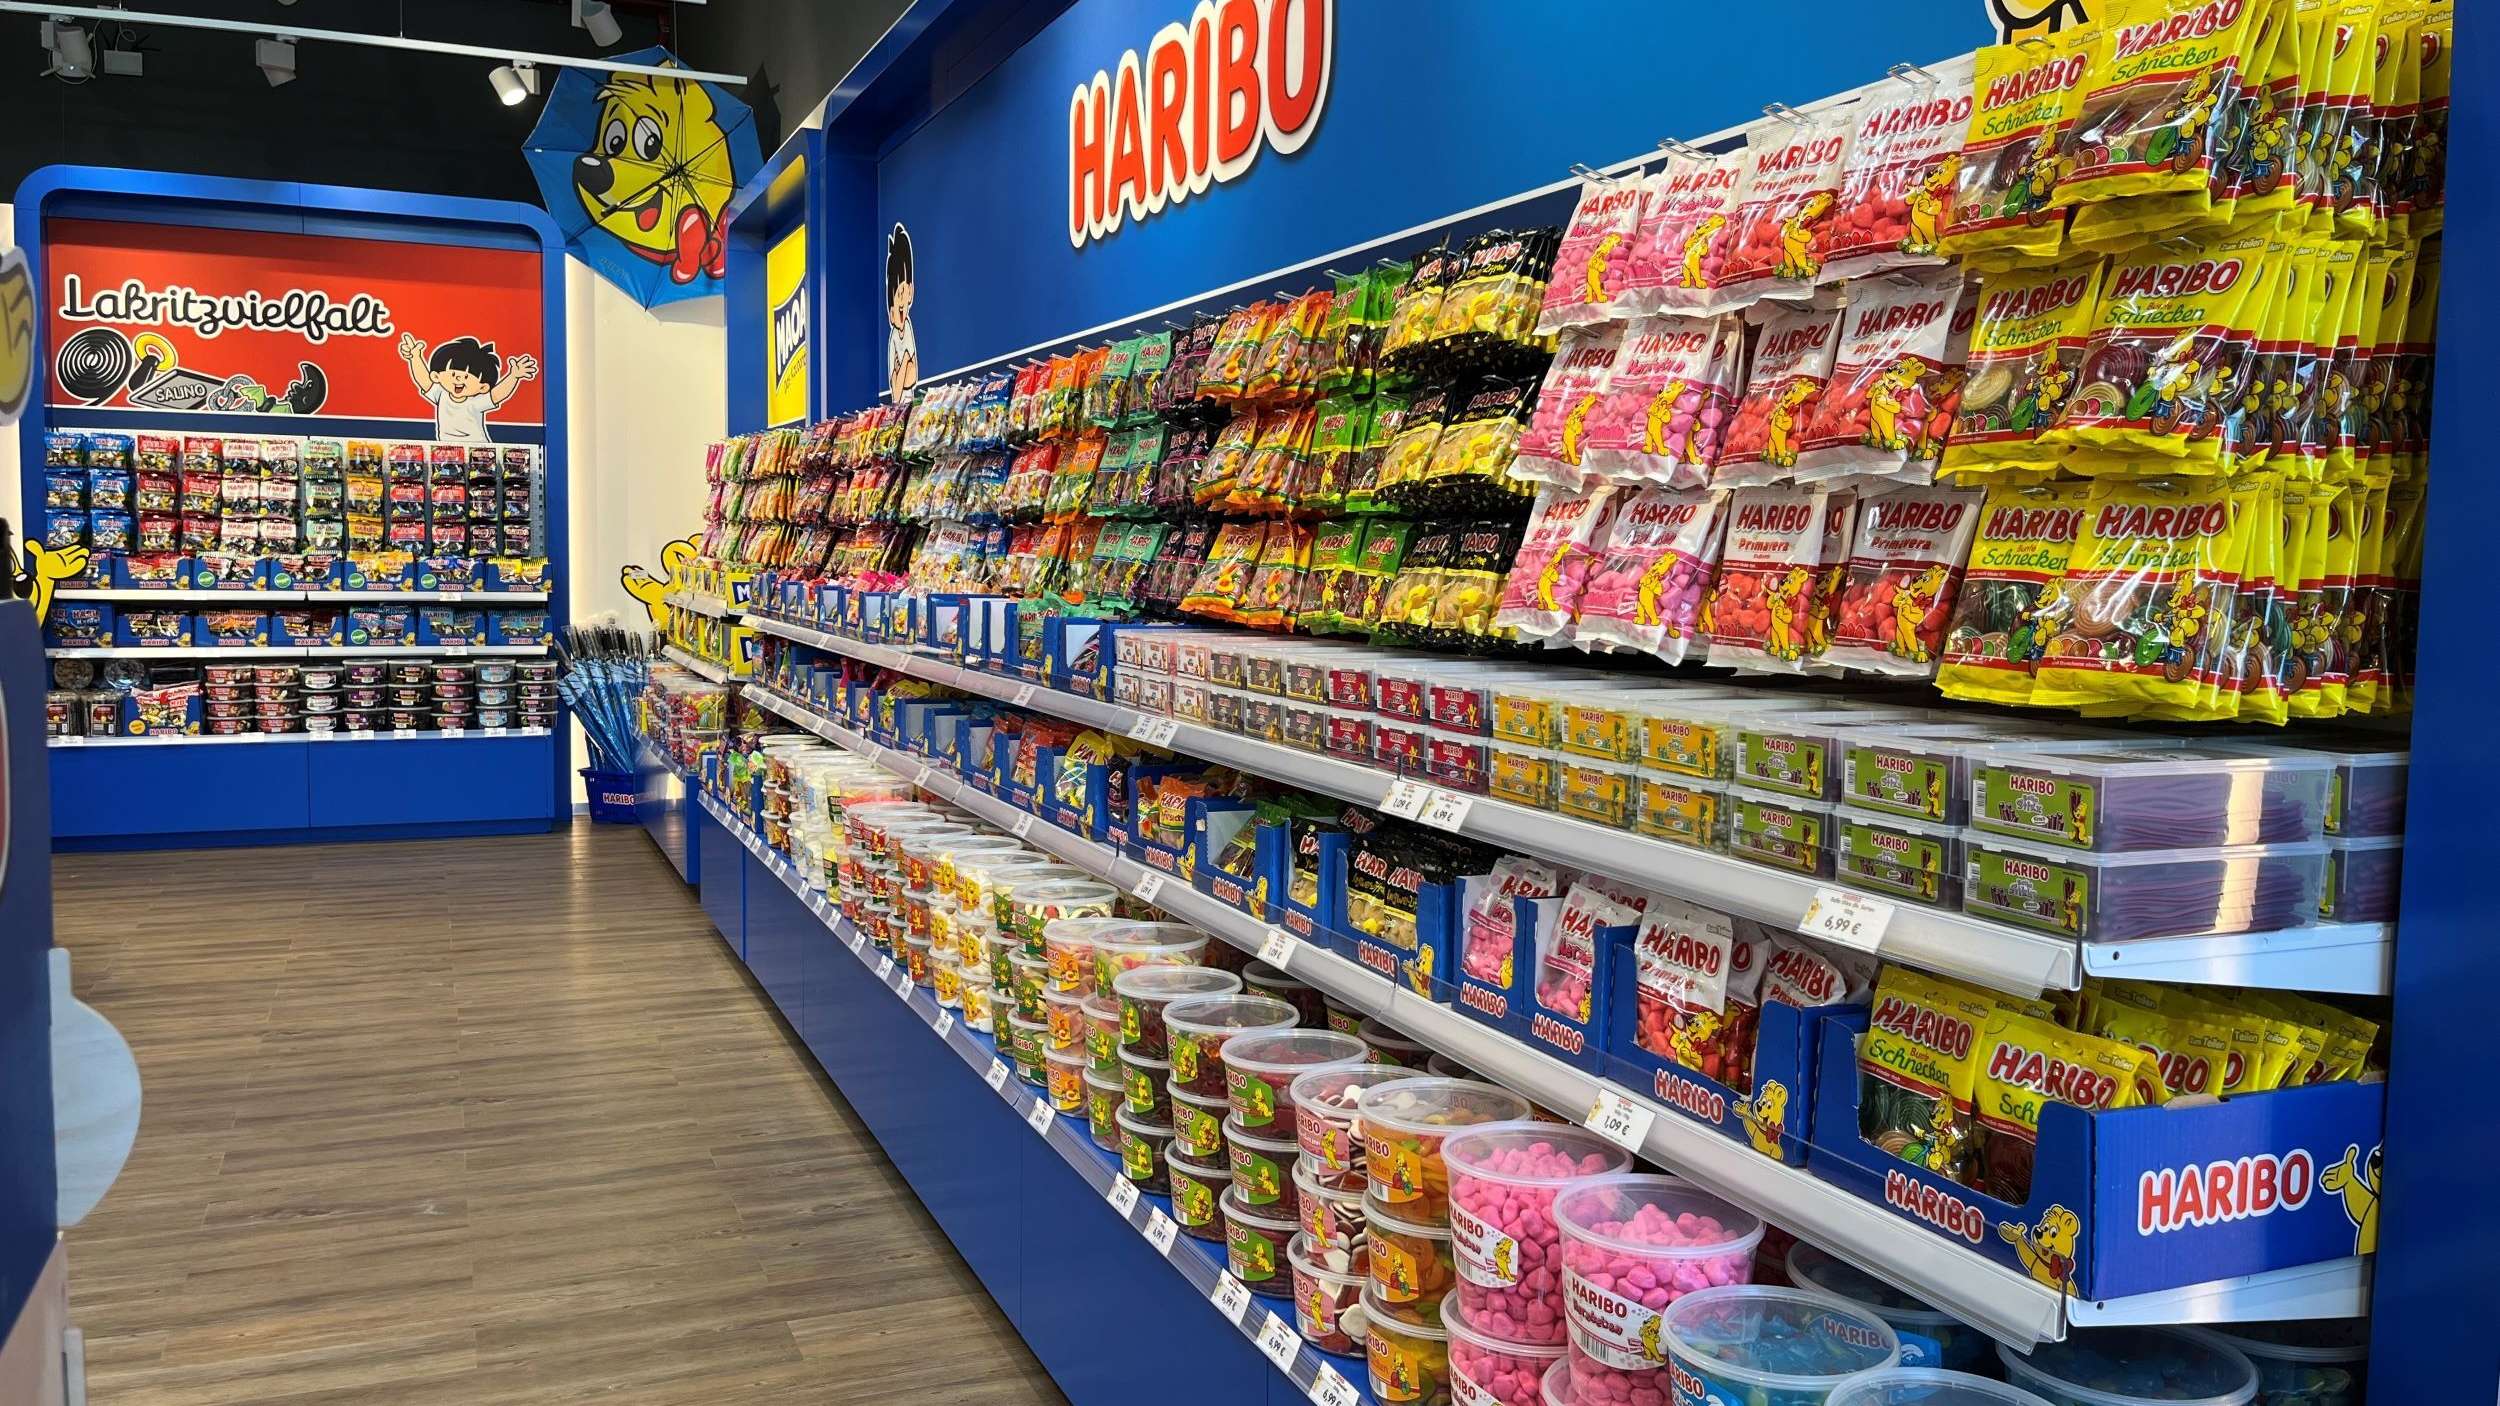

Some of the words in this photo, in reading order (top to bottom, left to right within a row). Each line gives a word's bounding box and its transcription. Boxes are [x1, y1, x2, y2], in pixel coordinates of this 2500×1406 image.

[2115, 0, 2246, 61] HARIBO
[2111, 45, 2218, 82] Schnecken
[1981, 52, 2088, 111] HARIBO
[1071, 0, 1332, 248] HARIBO
[1858, 95, 1975, 143] HARIBO
[1983, 103, 2063, 136] Schnecken
[1757, 135, 1843, 178] HARIBO
[1580, 188, 1637, 218] HARBO
[1666, 167, 1742, 215] HARBO
[2108, 257, 2244, 301] HARIBO
[61, 276, 392, 342] Lakritzvielfalt
[1981, 272, 2091, 324] HARIBO
[1853, 301, 1946, 341] HARIBO
[2104, 304, 2206, 326] Schnecken
[776, 288, 807, 375] MAOA
[1634, 331, 1709, 358] HARIBO
[1983, 320, 2063, 347] Schnecken
[1562, 346, 1618, 371] HARBO
[155, 384, 206, 402] SALINO
[1629, 501, 1698, 527] HARBO
[1737, 501, 1816, 534] HARIBO
[1871, 501, 1967, 534] HARIBO
[2095, 501, 2228, 540] HARIBO
[1736, 536, 1795, 553] Primavera
[2100, 546, 2201, 570] Schnecken
[1981, 547, 2068, 571] Schnecken
[1509, 699, 1531, 712] HARIBO
[1580, 711, 1606, 724] HARIBO
[1662, 722, 1691, 737] HARIBO
[1763, 736, 1797, 754] HARIBO
[1507, 757, 1529, 771] HARIBO
[1876, 754, 1914, 773] HARIBO
[1579, 771, 1604, 786] HARIBO
[2009, 774, 2056, 796] HARIBO
[602, 792, 635, 805] HARIBO
[1660, 788, 1689, 804] HARIBO
[1760, 808, 1793, 828] HARIBO
[1871, 832, 1910, 852] HARIBO
[1145, 845, 1175, 872] HARIBO
[2004, 859, 2050, 882] HARIBO
[1211, 876, 1245, 904] HARIBO
[1284, 907, 1313, 937] HARIBO
[1824, 915, 1851, 932] 6,99
[1852, 922, 1863, 935] €
[1358, 939, 1400, 978] HARIBO
[1643, 924, 1722, 977] HARIBO
[1460, 982, 1508, 1019] HARIBO
[1532, 1013, 1585, 1056] HARIBO
[1871, 996, 1974, 1060] HARIBO
[1868, 1037, 1951, 1088] Schnecken
[1987, 1042, 2118, 1110] HARIBO
[1226, 1068, 1248, 1089] ARIBO
[1654, 1067, 1725, 1125] HARIBO
[1173, 1102, 1194, 1122] ARIBO
[1298, 1113, 1321, 1136] ARIBO
[1603, 1115, 1620, 1131] 1,09
[1621, 1124, 1631, 1136] €
[1230, 1146, 1252, 1166] ARIBO
[1366, 1134, 1390, 1158] ARIBO
[1171, 1171, 1189, 1191] RIBO
[2138, 1148, 2315, 1237] HARIBO
[1885, 1168, 1984, 1245] HARIBO
[1226, 1222, 1248, 1243] ARIBO
[1369, 1233, 1388, 1258] RIBO
[1571, 1276, 1629, 1320] HARIBO
[1268, 1335, 1281, 1352] 6,99
[1368, 1330, 1388, 1357] RIBO
[1322, 1387, 1336, 1405] 6,99
